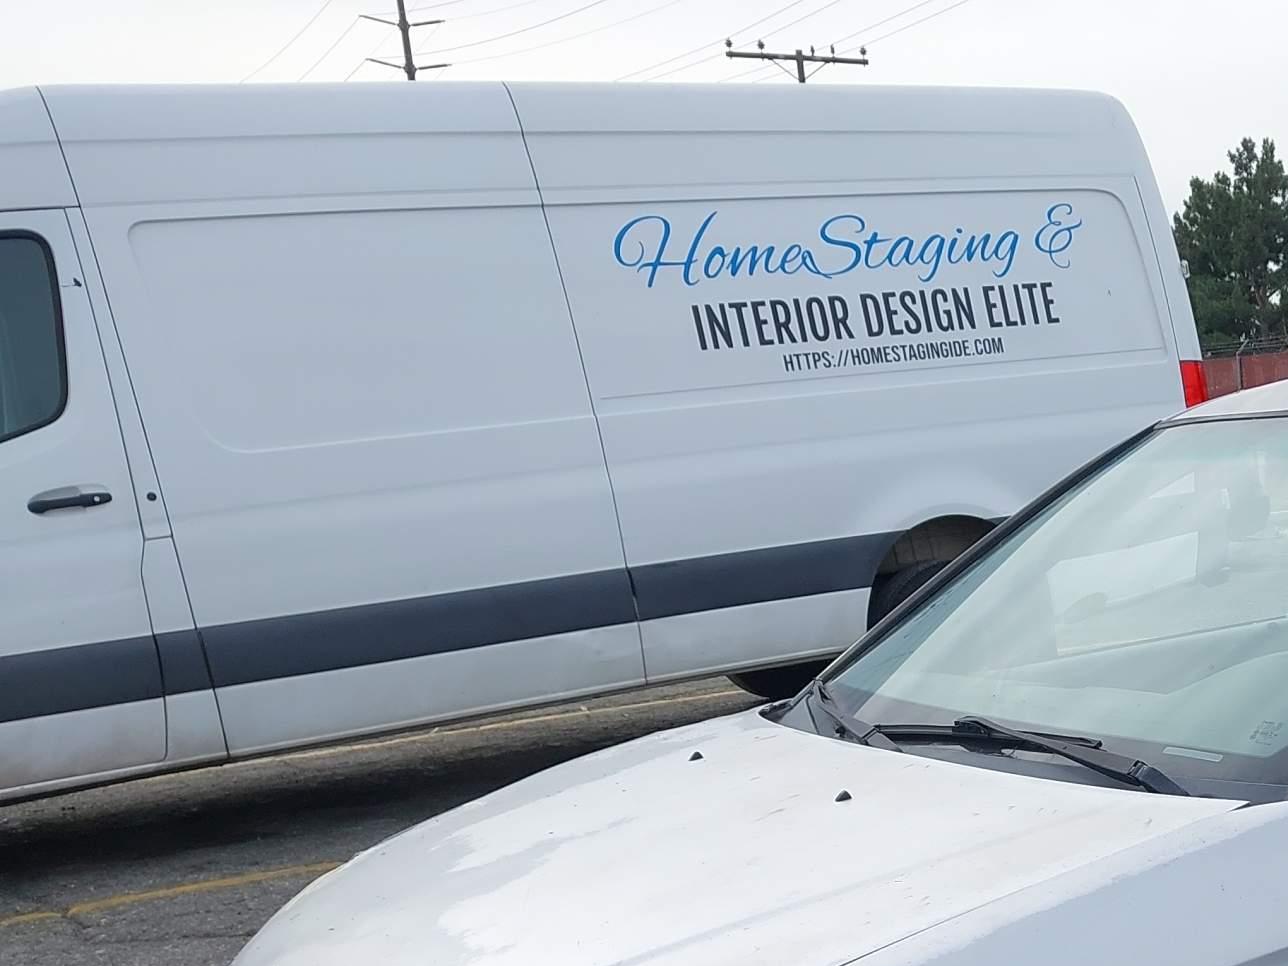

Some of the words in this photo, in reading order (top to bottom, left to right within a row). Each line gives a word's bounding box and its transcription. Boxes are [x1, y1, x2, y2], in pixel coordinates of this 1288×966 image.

[1034, 203, 1082, 269] &
[691, 294, 855, 350] INTERIOR
[859, 286, 977, 338] DESIGN
[981, 281, 1061, 329] ELITE
[783, 336, 1005, 372] HTTPS://HOMESTAGINGIDE.COM
